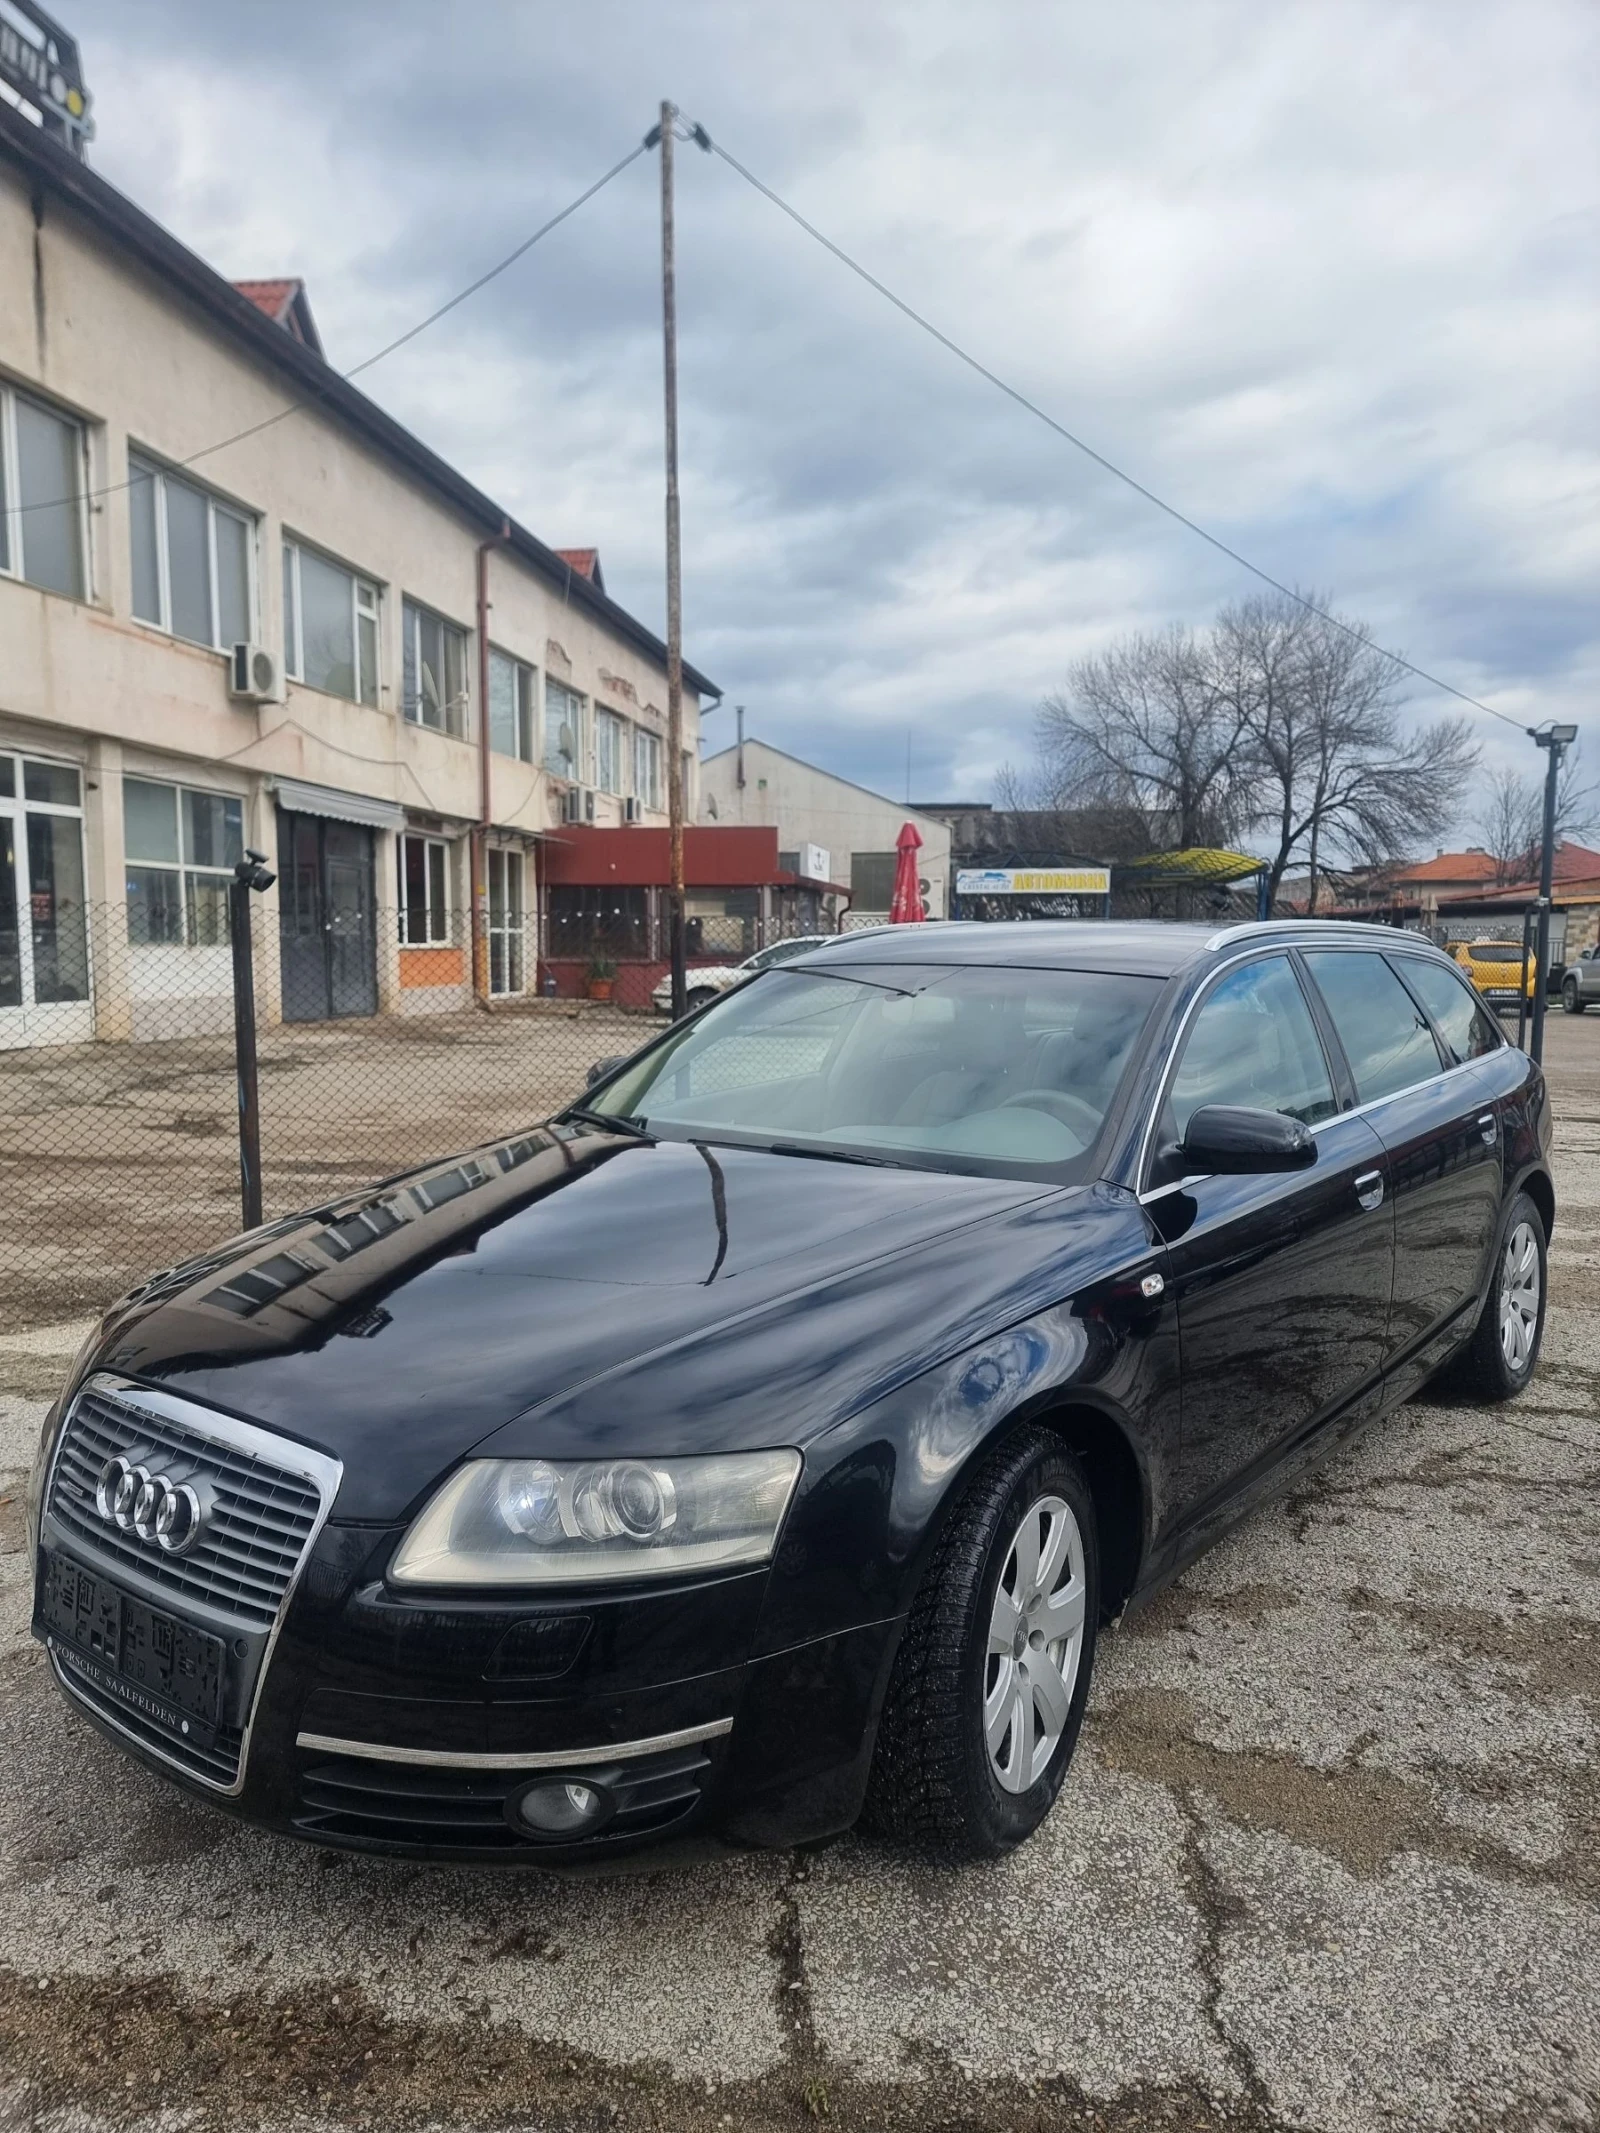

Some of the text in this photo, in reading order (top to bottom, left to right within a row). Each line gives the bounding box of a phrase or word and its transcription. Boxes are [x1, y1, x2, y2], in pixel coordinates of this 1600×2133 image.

[1012, 873, 1107, 890] АВТОМИВКА
[56, 1642, 177, 1726] PORSCHE SAALFELDEN
